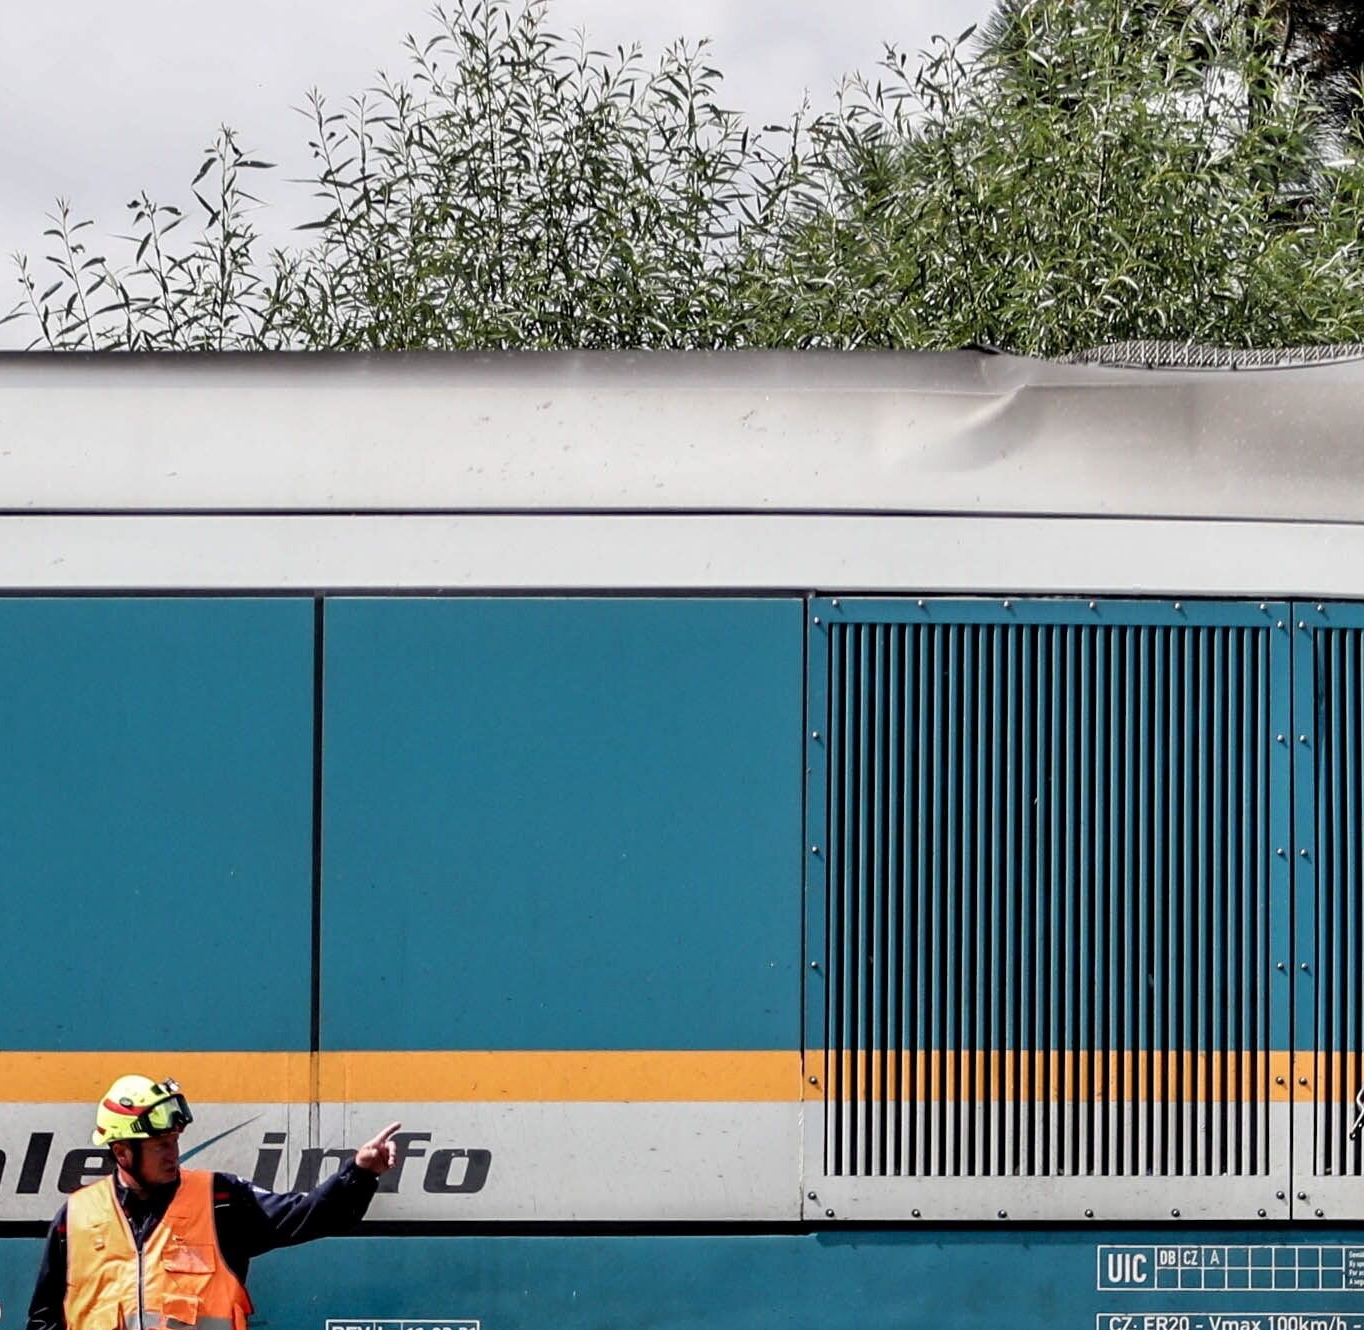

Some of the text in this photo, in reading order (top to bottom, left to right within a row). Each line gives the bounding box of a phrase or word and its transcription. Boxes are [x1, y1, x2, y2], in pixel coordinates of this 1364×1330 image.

[1107, 1250, 1220, 1283] UIC DB CZ A
